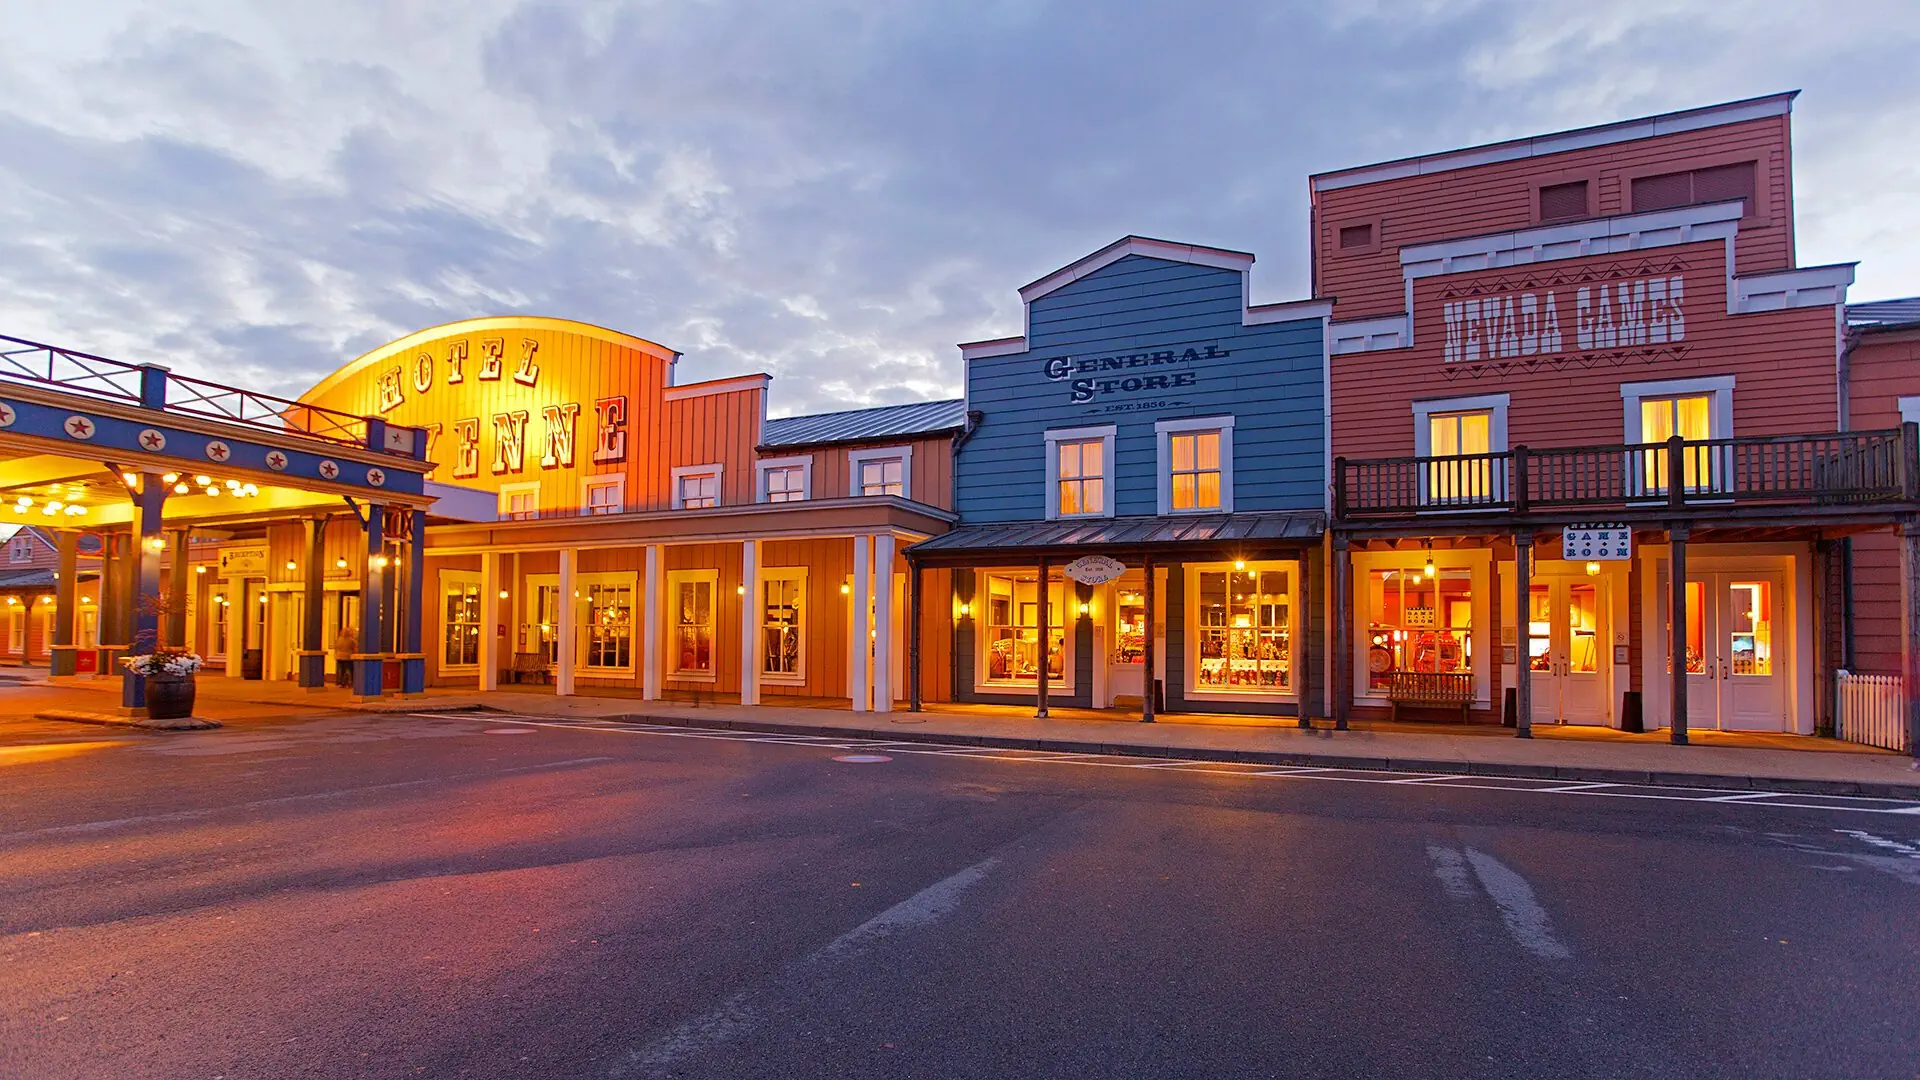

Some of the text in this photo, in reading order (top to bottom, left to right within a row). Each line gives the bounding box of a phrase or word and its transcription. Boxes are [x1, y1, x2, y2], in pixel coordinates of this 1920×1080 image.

[1443, 274, 1685, 364] NEVADA GAMES
[377, 337, 539, 413] HOTEL
[1044, 345, 1230, 380] GENERAL
[1070, 372, 1197, 403] STORE
[1566, 548, 1628, 556] ROOM
[1567, 532, 1628, 540] GAME
